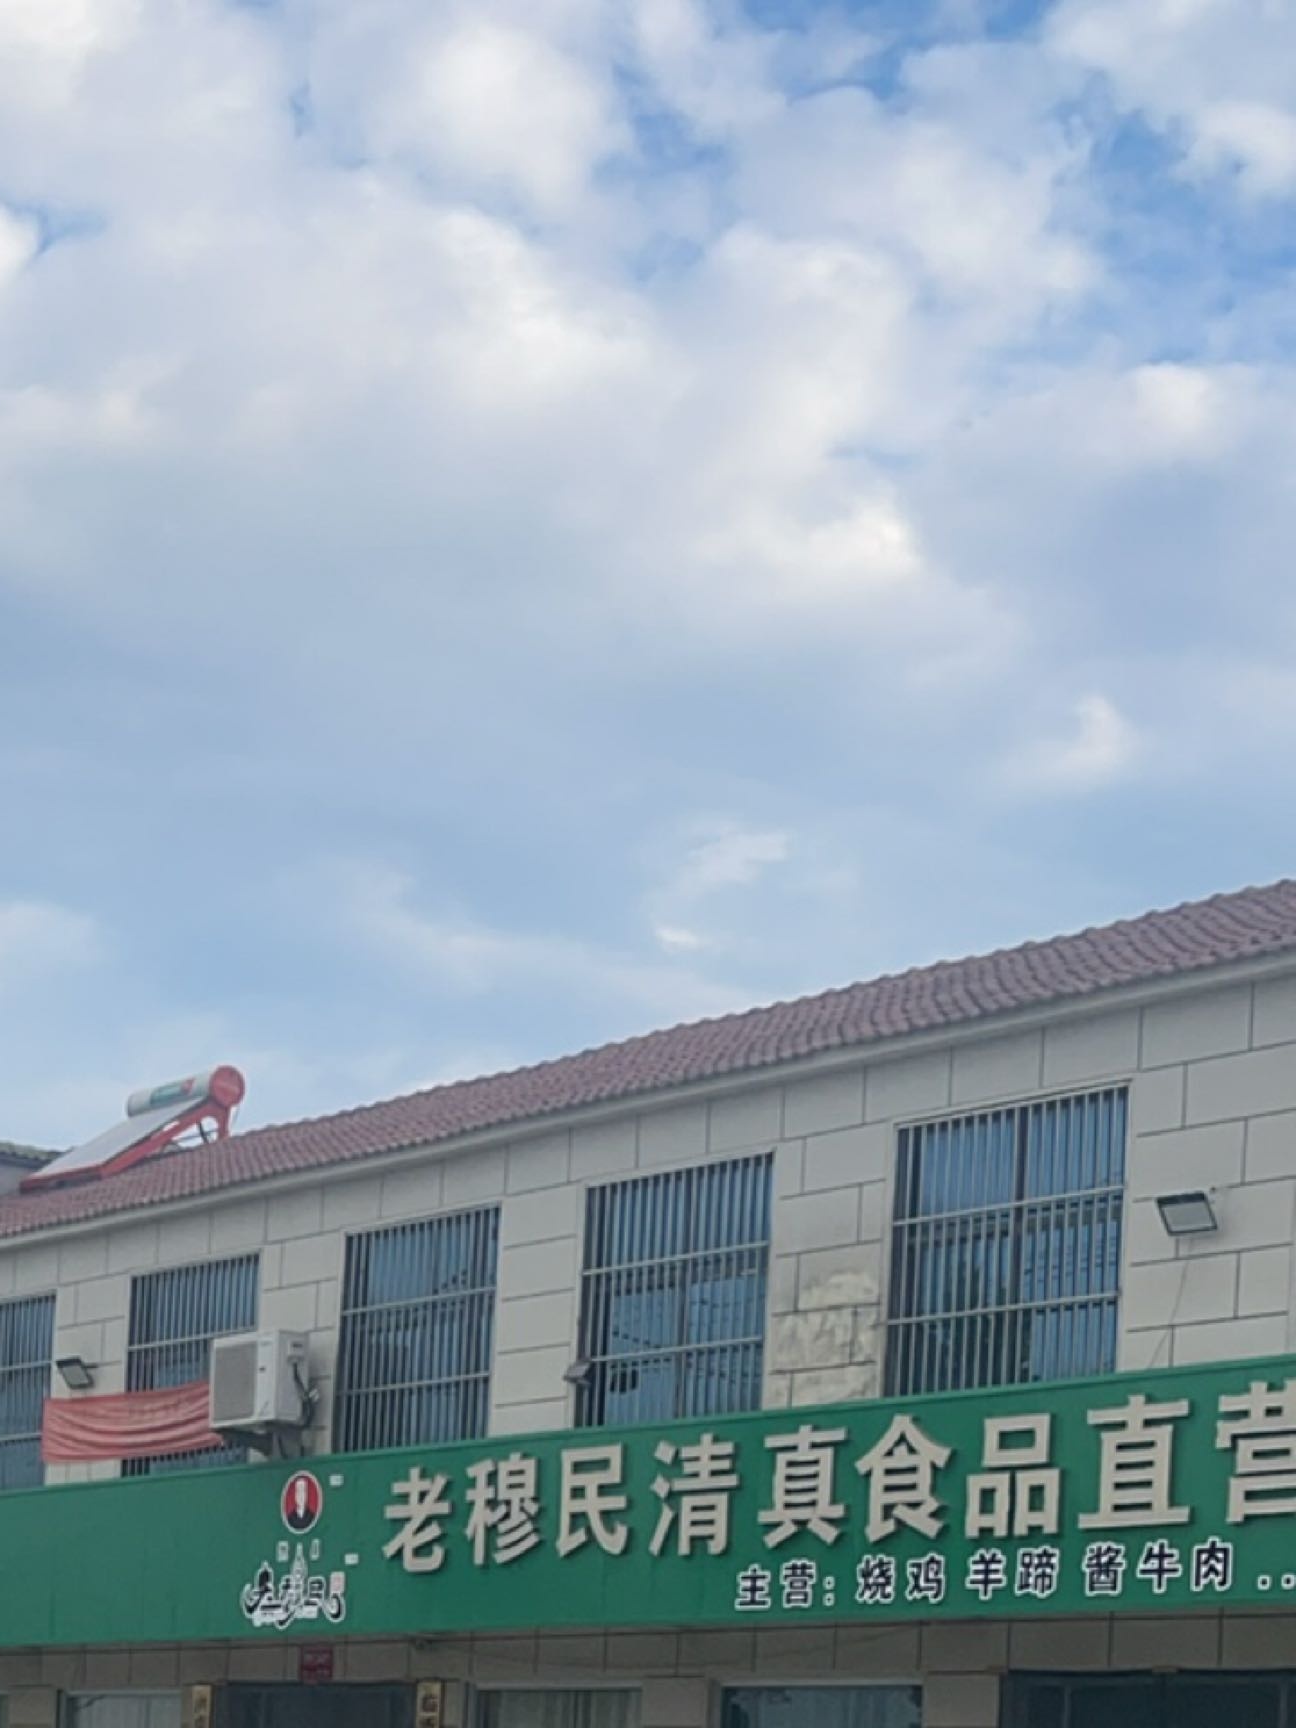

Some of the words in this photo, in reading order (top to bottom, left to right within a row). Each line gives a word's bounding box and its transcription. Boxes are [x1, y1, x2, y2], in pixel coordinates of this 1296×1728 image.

[382, 1379, 1296, 1574] 老穆民清真食品直营
[856, 1555, 946, 1602] 烧鸡
[966, 1547, 1059, 1599] 羊蹄
[1083, 1538, 1234, 1595] 酱牛肉
